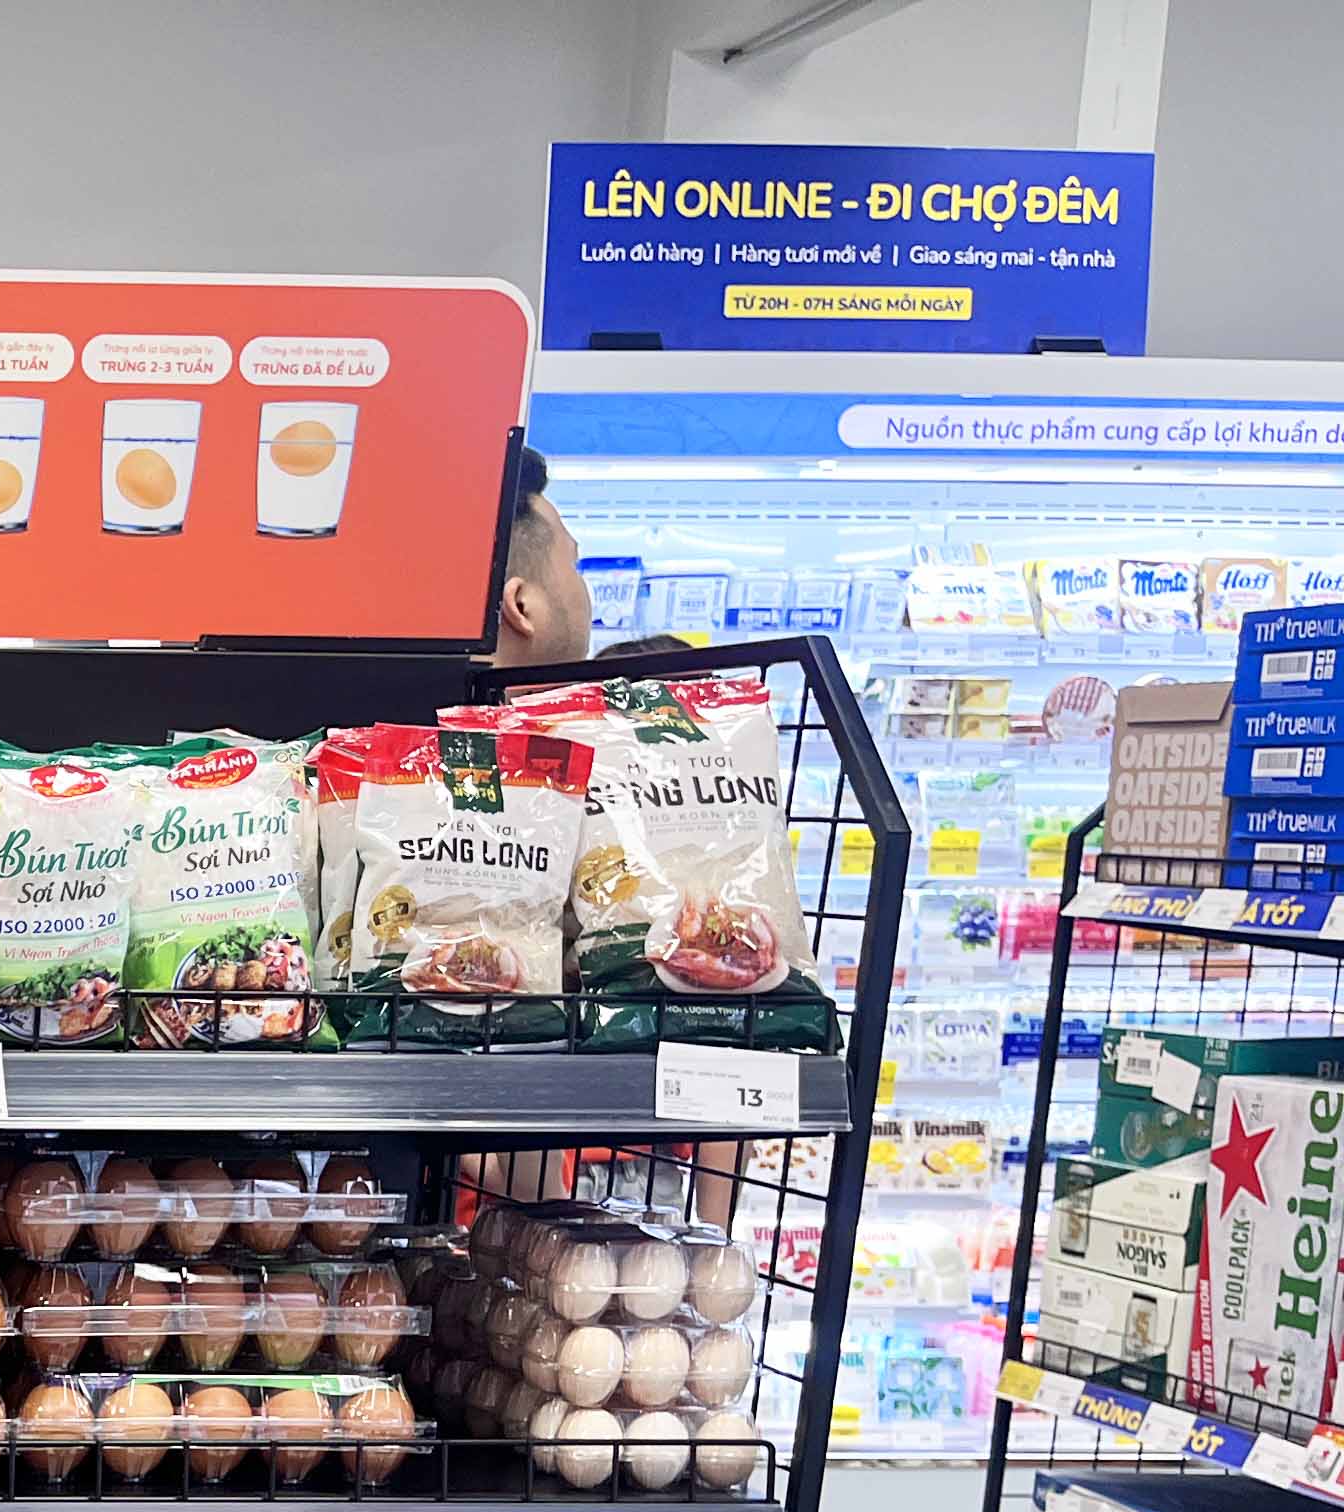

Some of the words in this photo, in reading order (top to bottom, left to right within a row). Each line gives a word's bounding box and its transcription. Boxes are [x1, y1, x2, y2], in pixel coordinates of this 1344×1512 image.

[583, 168, 665, 218] LÊN
[674, 180, 833, 219] ONLINE
[867, 182, 912, 220] ĐI
[922, 180, 1018, 232] CHỢ
[1023, 176, 1119, 224] ĐÊM
[581, 242, 626, 262] Luôn
[630, 244, 654, 262] đủ
[658, 242, 703, 266] hàng
[732, 244, 779, 267] Hàng
[785, 246, 818, 263] tươi
[824, 245, 856, 263] mới
[860, 244, 882, 263] về
[910, 246, 950, 265] Giao
[955, 246, 997, 268] sáng
[1001, 248, 1033, 267] mai
[1051, 247, 1079, 270] tận
[1083, 249, 1115, 268] nhà
[734, 294, 756, 310] TỪ
[759, 297, 788, 310] 20H
[804, 297, 833, 310] 07H
[839, 295, 882, 311] SÁNG
[921, 296, 964, 313] NGÀY
[0, 359, 7, 370] 1
[150, 361, 172, 373] 2-3
[886, 415, 964, 443] Nguồn
[972, 417, 1024, 447] thực
[1030, 416, 1095, 444] phẩm
[1103, 424, 1159, 444] cung
[1166, 420, 1206, 444] cấp
[1214, 420, 1241, 447] lợi
[1249, 419, 1317, 444] khuẩn
[483, 840, 549, 873] LONG
[736, 1087, 763, 1107] 13
[913, 1120, 985, 1137] Vinamilk
[1223, 1218, 1251, 1321] COOLPACK
